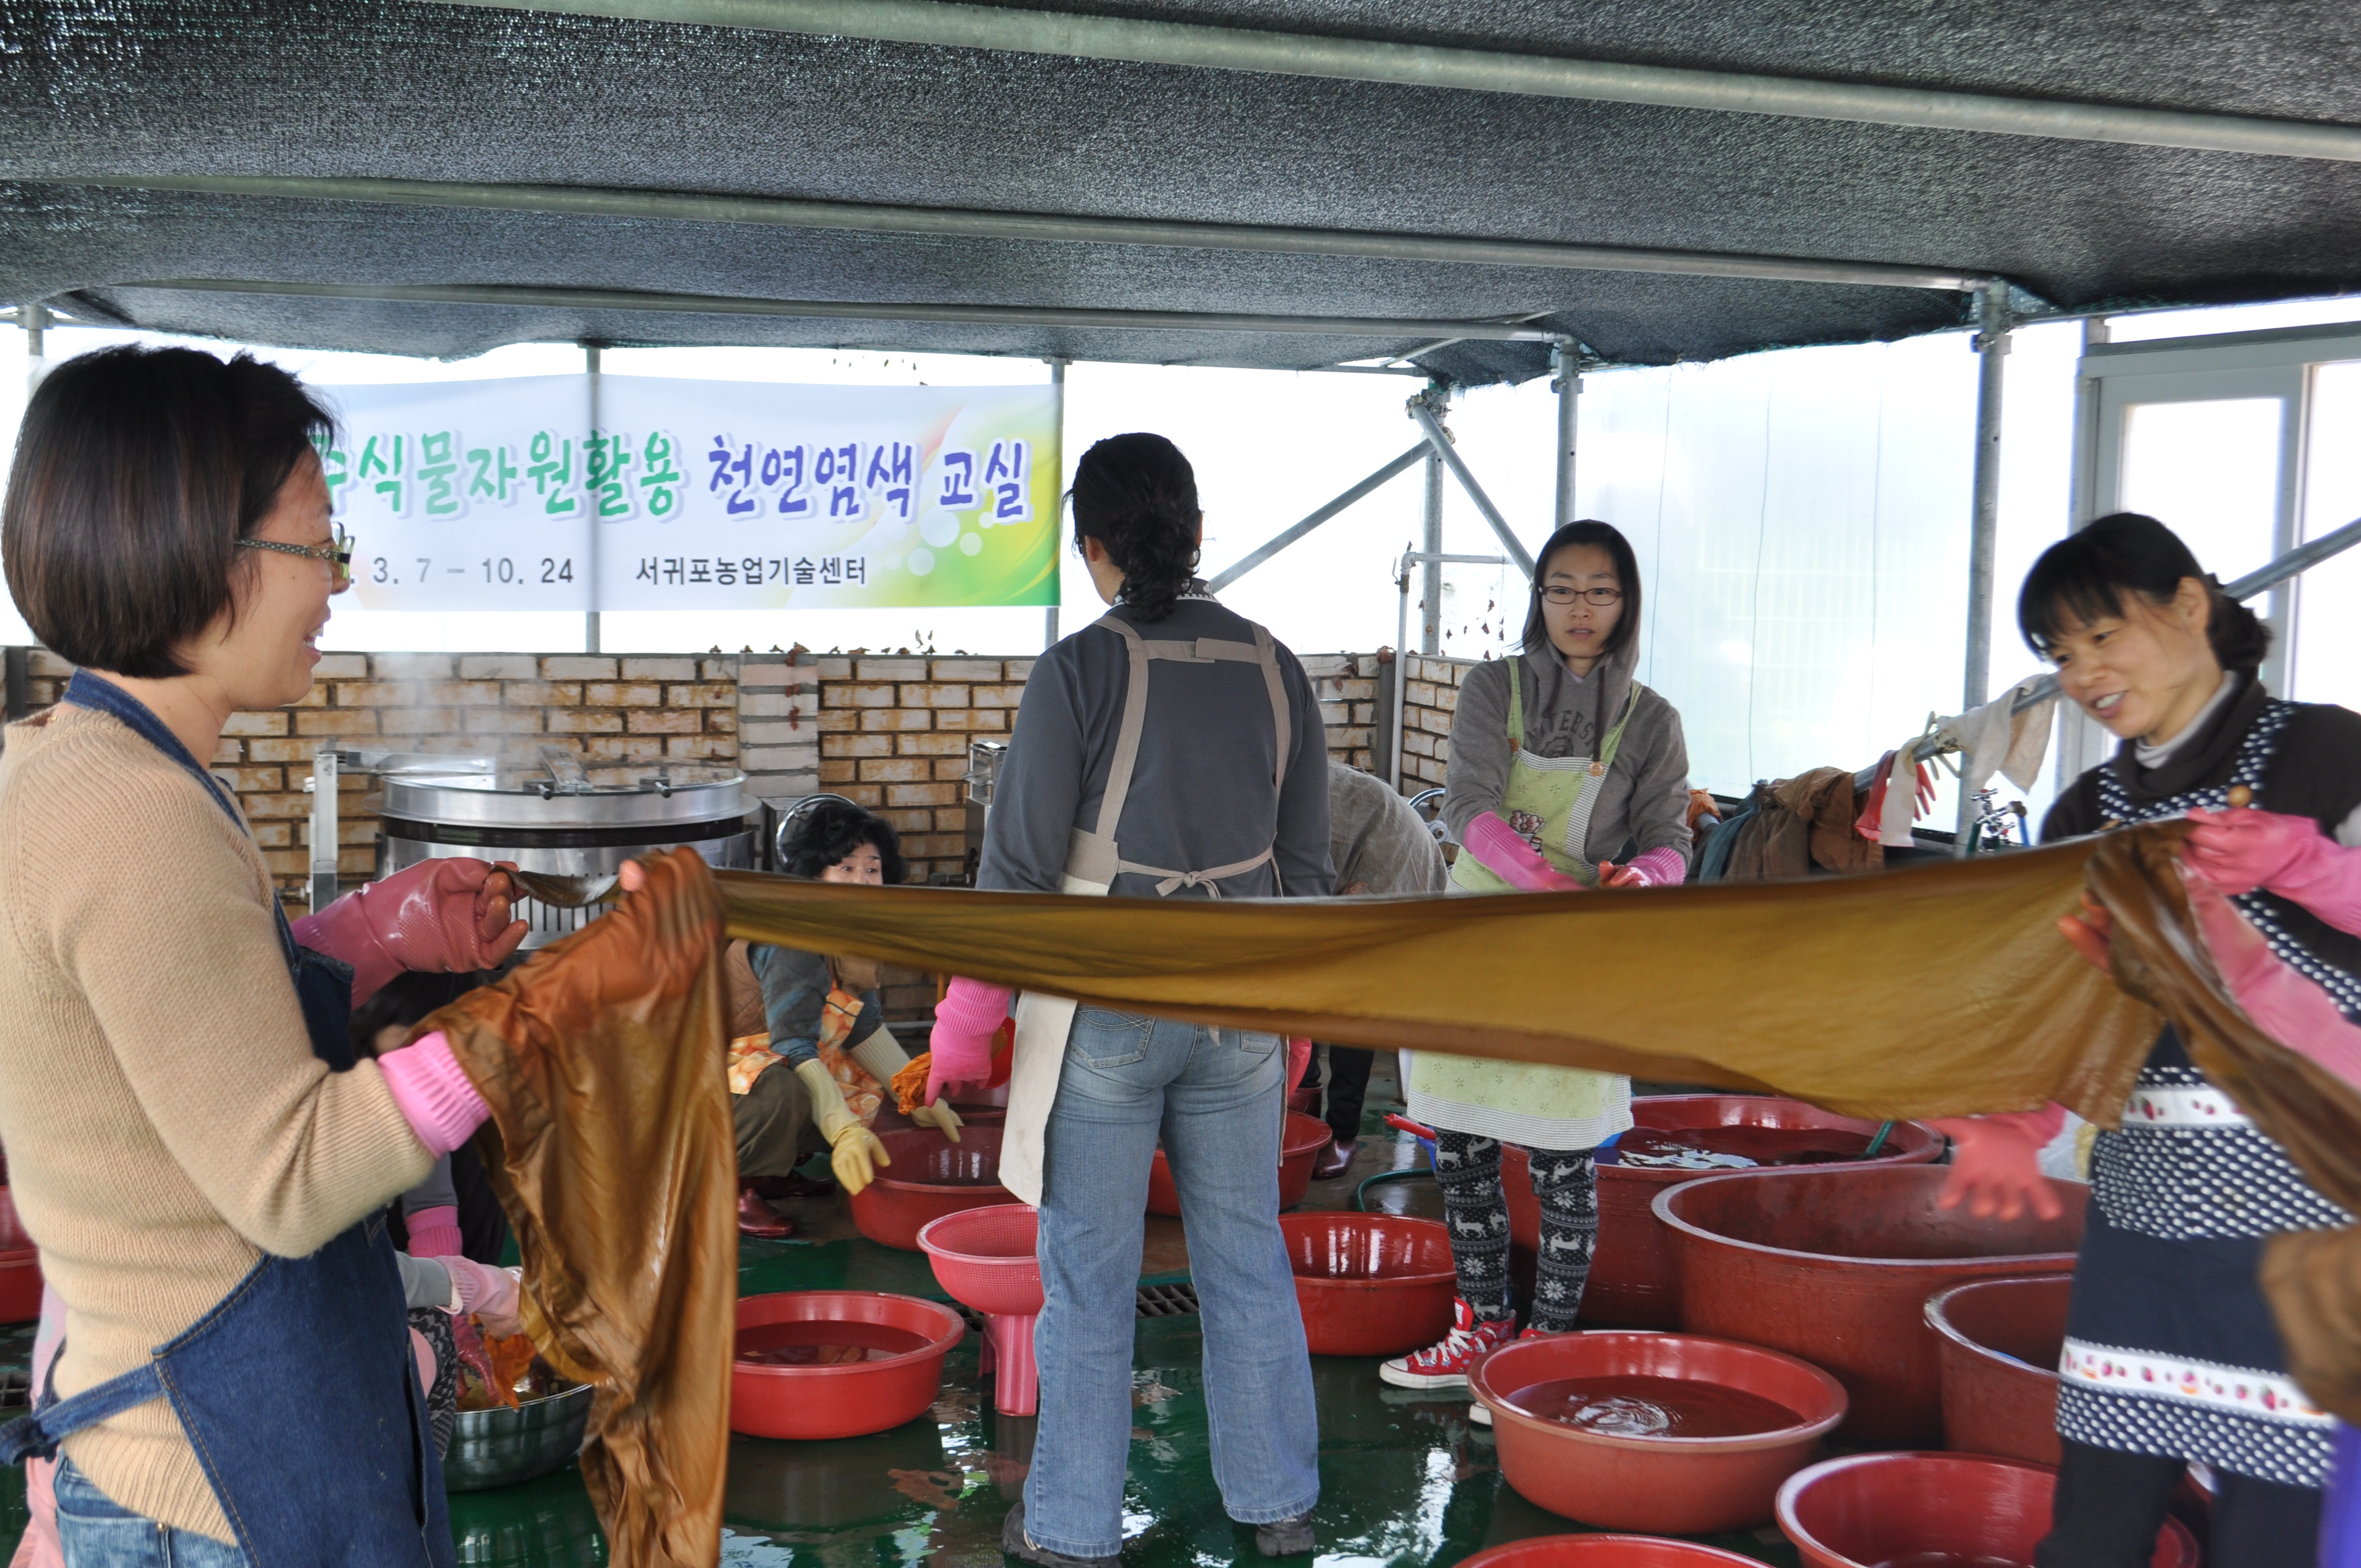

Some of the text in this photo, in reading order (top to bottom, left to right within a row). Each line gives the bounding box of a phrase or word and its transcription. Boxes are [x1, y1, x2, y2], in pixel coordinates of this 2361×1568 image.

[709, 435, 911, 518] 천연염색
[940, 443, 1022, 518] 교실
[416, 557, 432, 584] 7
[541, 557, 574, 584] 24
[637, 557, 866, 586] 서귀포농업기술센터
